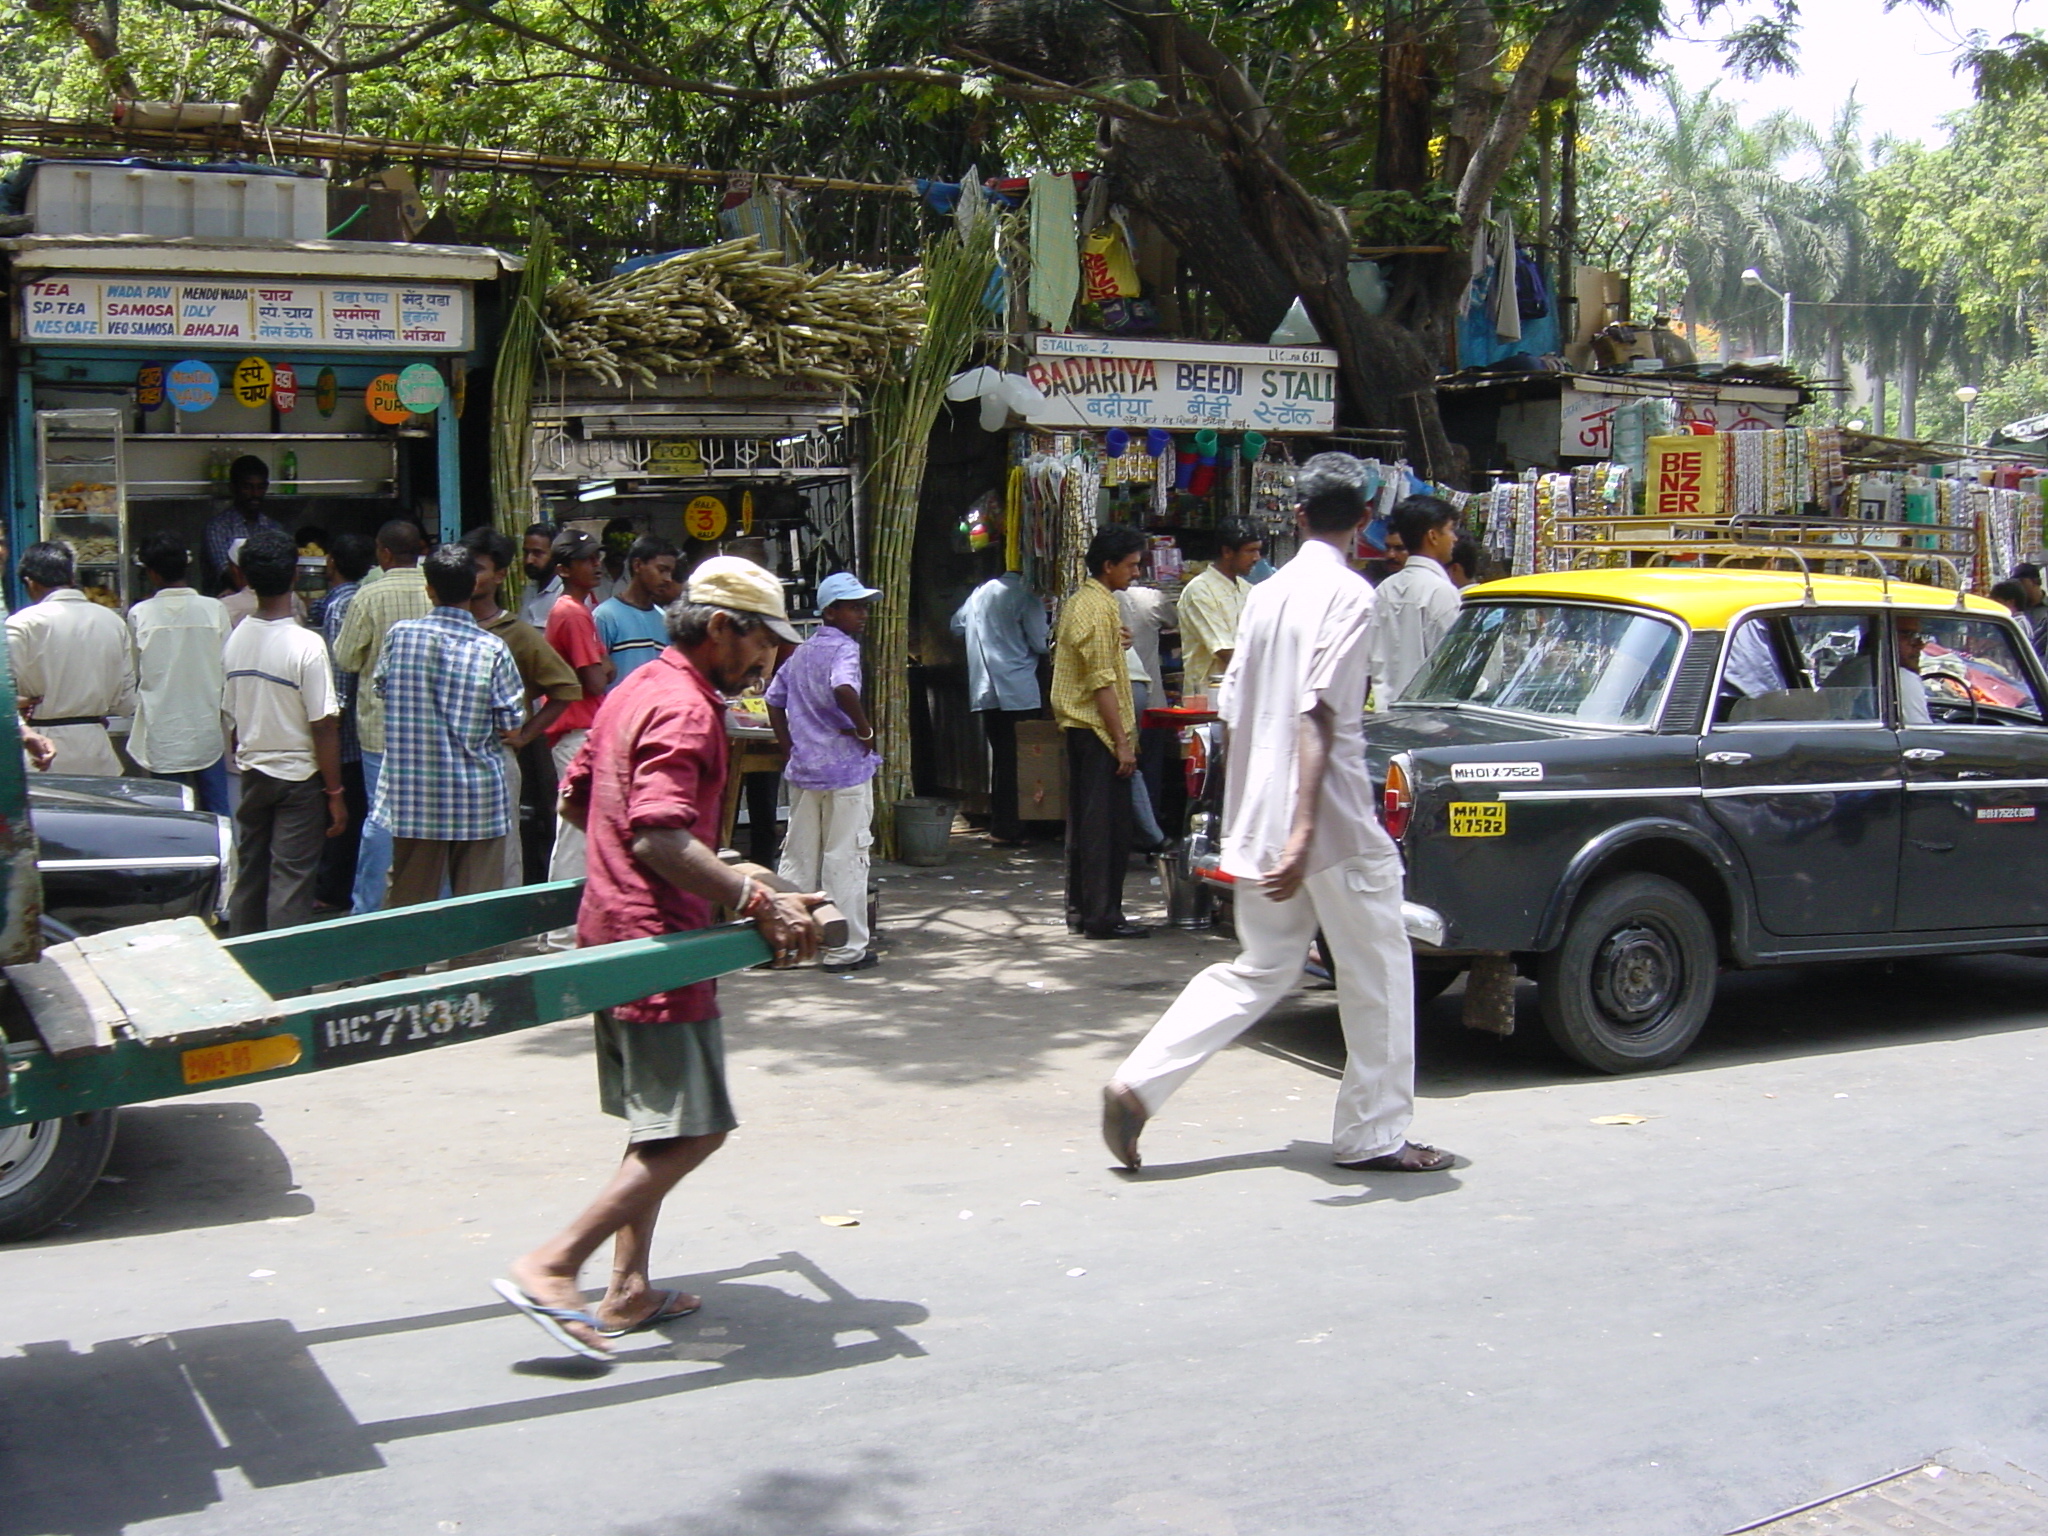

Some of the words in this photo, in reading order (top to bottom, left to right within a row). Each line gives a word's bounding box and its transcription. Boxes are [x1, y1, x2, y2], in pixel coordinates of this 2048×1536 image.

[32, 283, 69, 296] TEA
[258, 290, 293, 301] चाय
[363, 292, 389, 304] पाव
[426, 294, 451, 306] वडा
[107, 304, 173, 316] SAMOSA
[183, 305, 216, 317] IDLY
[281, 307, 313, 319] चाय
[332, 304, 381, 323] समोसा
[131, 322, 174, 335] SAMOSA
[183, 324, 239, 337] BHAJIA
[356, 325, 396, 344] समोसा
[402, 326, 446, 342] भजिया
[1042, 339, 1074, 352] STALL
[240, 360, 264, 383] स्पे.
[275, 370, 293, 388] वडा
[1027, 356, 1158, 398] BADARIYA
[1176, 363, 1243, 396] BEEDI
[240, 384, 270, 402] चाय
[375, 379, 400, 392] Shi
[276, 391, 296, 408] पाव
[373, 397, 409, 412] PUR
[660, 446, 690, 458] PCO
[1661, 452, 1702, 473] BE
[1660, 472, 1701, 493] NZ
[1659, 493, 1700, 513] ER
[697, 510, 715, 530] 3
